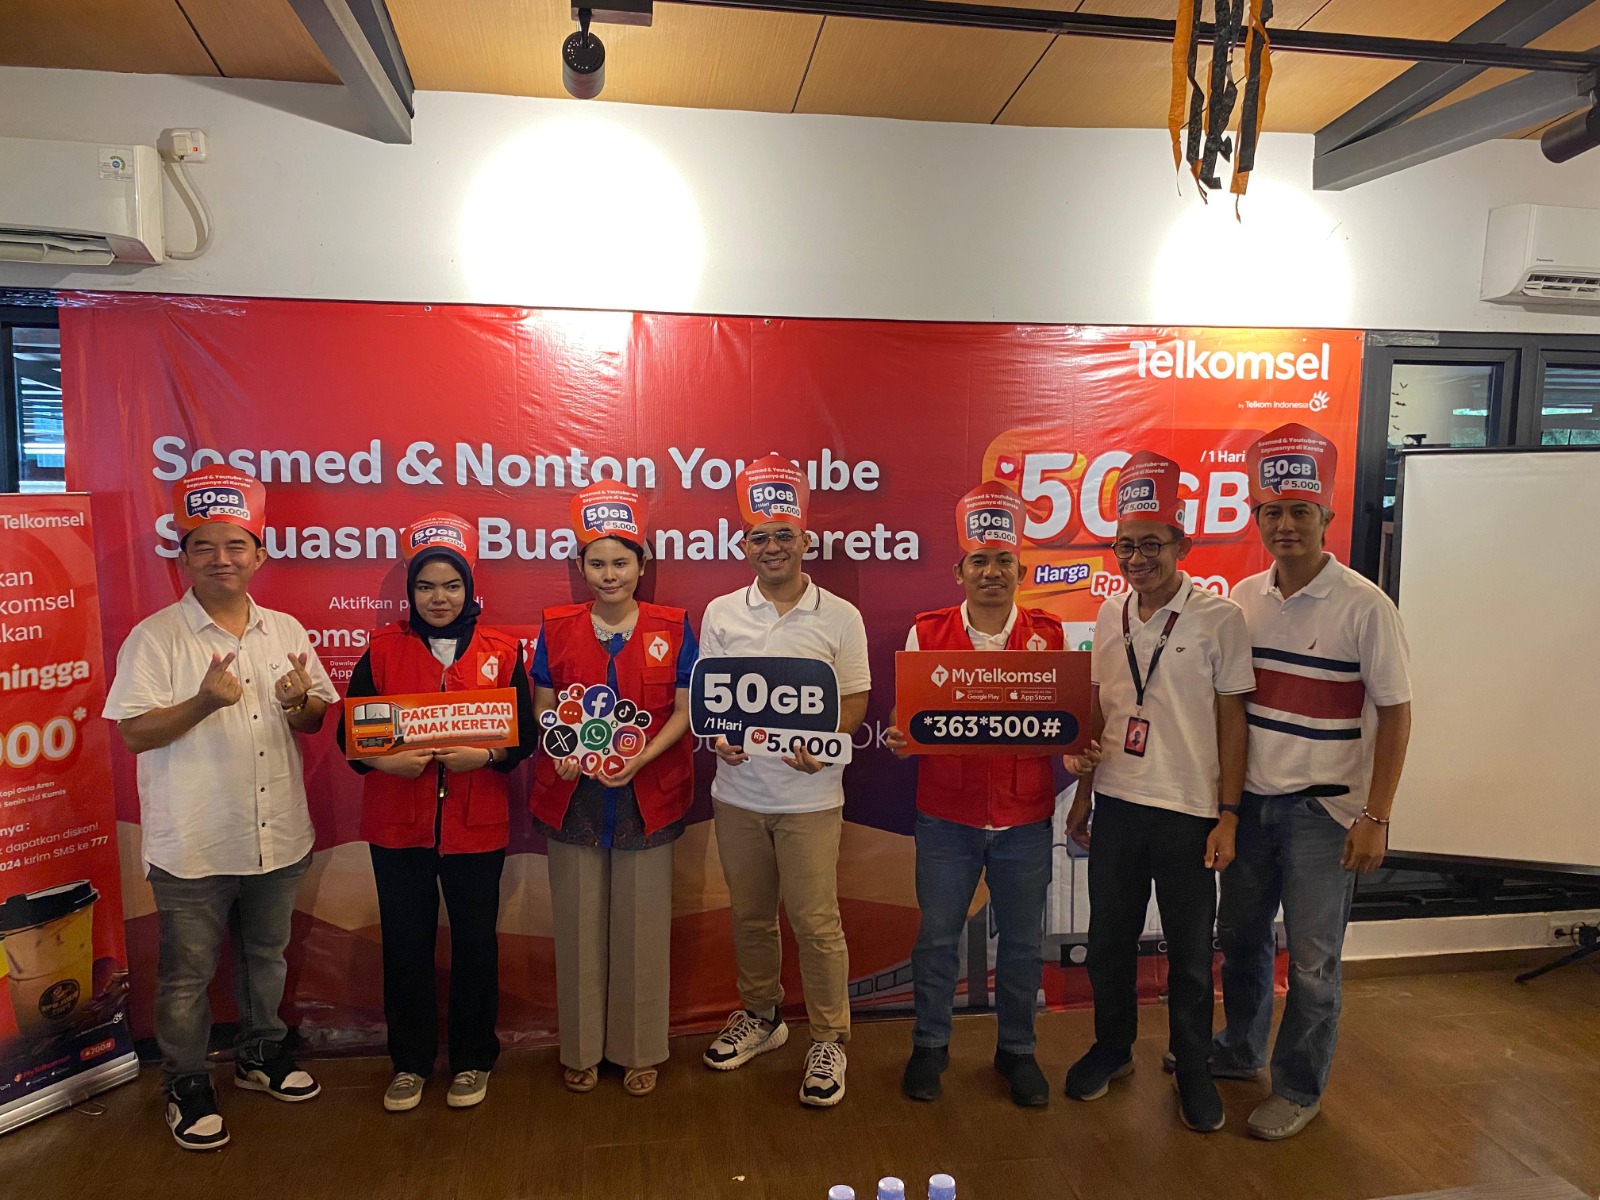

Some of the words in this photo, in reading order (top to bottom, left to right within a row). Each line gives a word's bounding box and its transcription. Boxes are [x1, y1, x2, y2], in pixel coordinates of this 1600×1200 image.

[1129, 340, 1330, 381] Telkomsel
[1245, 400, 1272, 409] Telkom
[1273, 401, 1309, 409] Indonesia
[152, 436, 382, 485] Sosmed
[396, 441, 443, 486] &
[456, 442, 656, 489] Nonton
[1217, 450, 1246, 463] Hari
[1263, 459, 1312, 478] 50GB
[752, 486, 794, 503] 50GB
[1291, 481, 1320, 491] 5.000
[190, 491, 239, 507] 50GB
[1118, 486, 1149, 505] 50GB
[219, 507, 249, 519] 5.000
[586, 506, 629, 521] 50GB
[780, 505, 800, 516] 5.000
[1129, 502, 1157, 511] 5.000
[3, 512, 85, 530] Telkomsel
[613, 522, 637, 532] 5.000
[969, 512, 1010, 529] 50GB
[414, 528, 457, 540] 50GB
[478, 516, 578, 561] Bua
[646, 517, 746, 561] nak
[804, 523, 920, 561] ereta
[993, 532, 1016, 543] 5.000
[1035, 563, 1089, 584] Harga
[1093, 574, 1122, 596] Rp
[329, 595, 393, 610] Aktifkan
[330, 668, 353, 680] App
[952, 668, 1057, 686] MyTelkomsel
[704, 672, 825, 715] 50GB
[988, 693, 1000, 701] Play
[401, 705, 448, 723] PAKET
[450, 704, 511, 717] JELAJAH
[406, 720, 448, 737] ANAK
[451, 718, 508, 733] KERETA
[717, 718, 742, 732] Hari
[753, 731, 766, 742] Rp
[766, 733, 842, 758] 5.000
[17, 786, 35, 794] Gula
[36, 781, 55, 790] Aren
[4, 798, 26, 807] Senin
[42, 789, 67, 799] Kamis
[6, 833, 60, 854] dapatkan
[63, 822, 99, 839] diskon!
[24, 852, 51, 866] kirim
[53, 844, 76, 858] SMS
[77, 842, 89, 851] ke
[91, 835, 109, 847] 777
